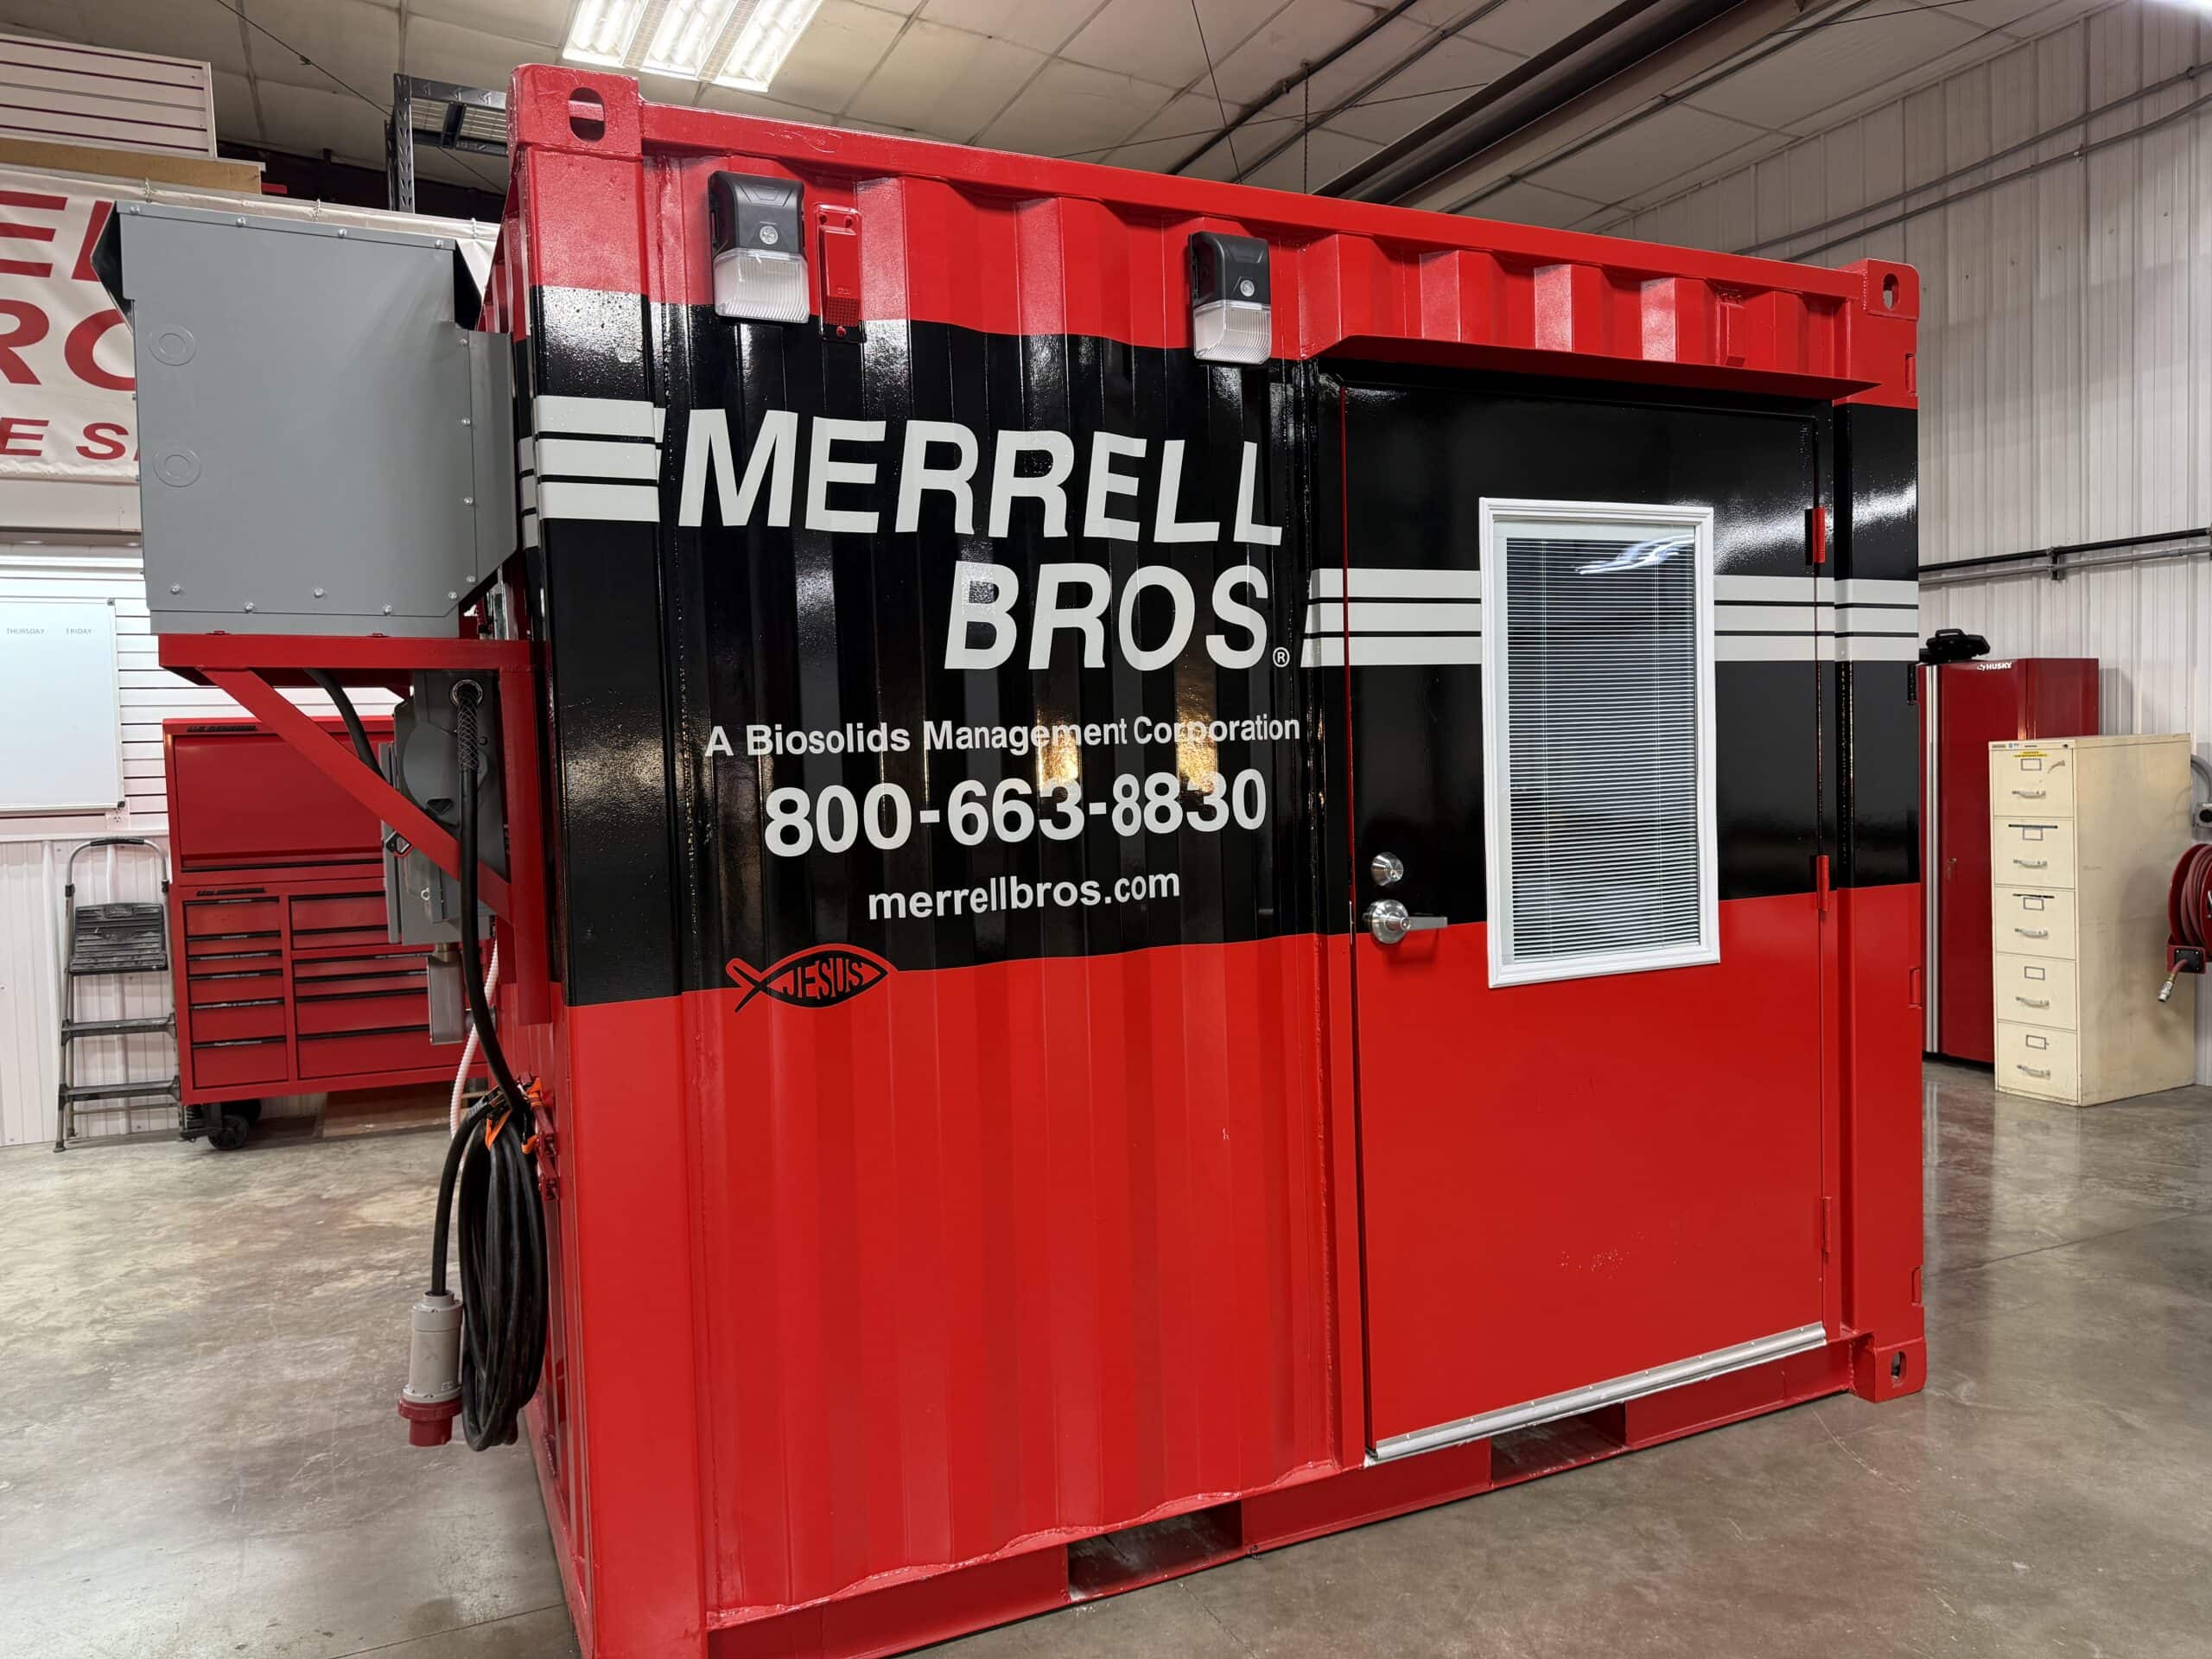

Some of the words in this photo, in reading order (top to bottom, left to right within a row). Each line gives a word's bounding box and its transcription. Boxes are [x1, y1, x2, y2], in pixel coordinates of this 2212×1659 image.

[679, 409, 1283, 546] MERRELL
[6, 627, 46, 636] THURSDAY
[1986, 661, 2012, 671] HUSKY
[704, 727, 734, 757] A
[746, 723, 912, 756] Biosolids
[923, 717, 1128, 756] Management
[1134, 713, 1301, 746] Corporation
[764, 766, 1268, 857] 800-663-8830
[868, 873, 1180, 920] merrellbros.com
[781, 957, 865, 1000] JESUS
